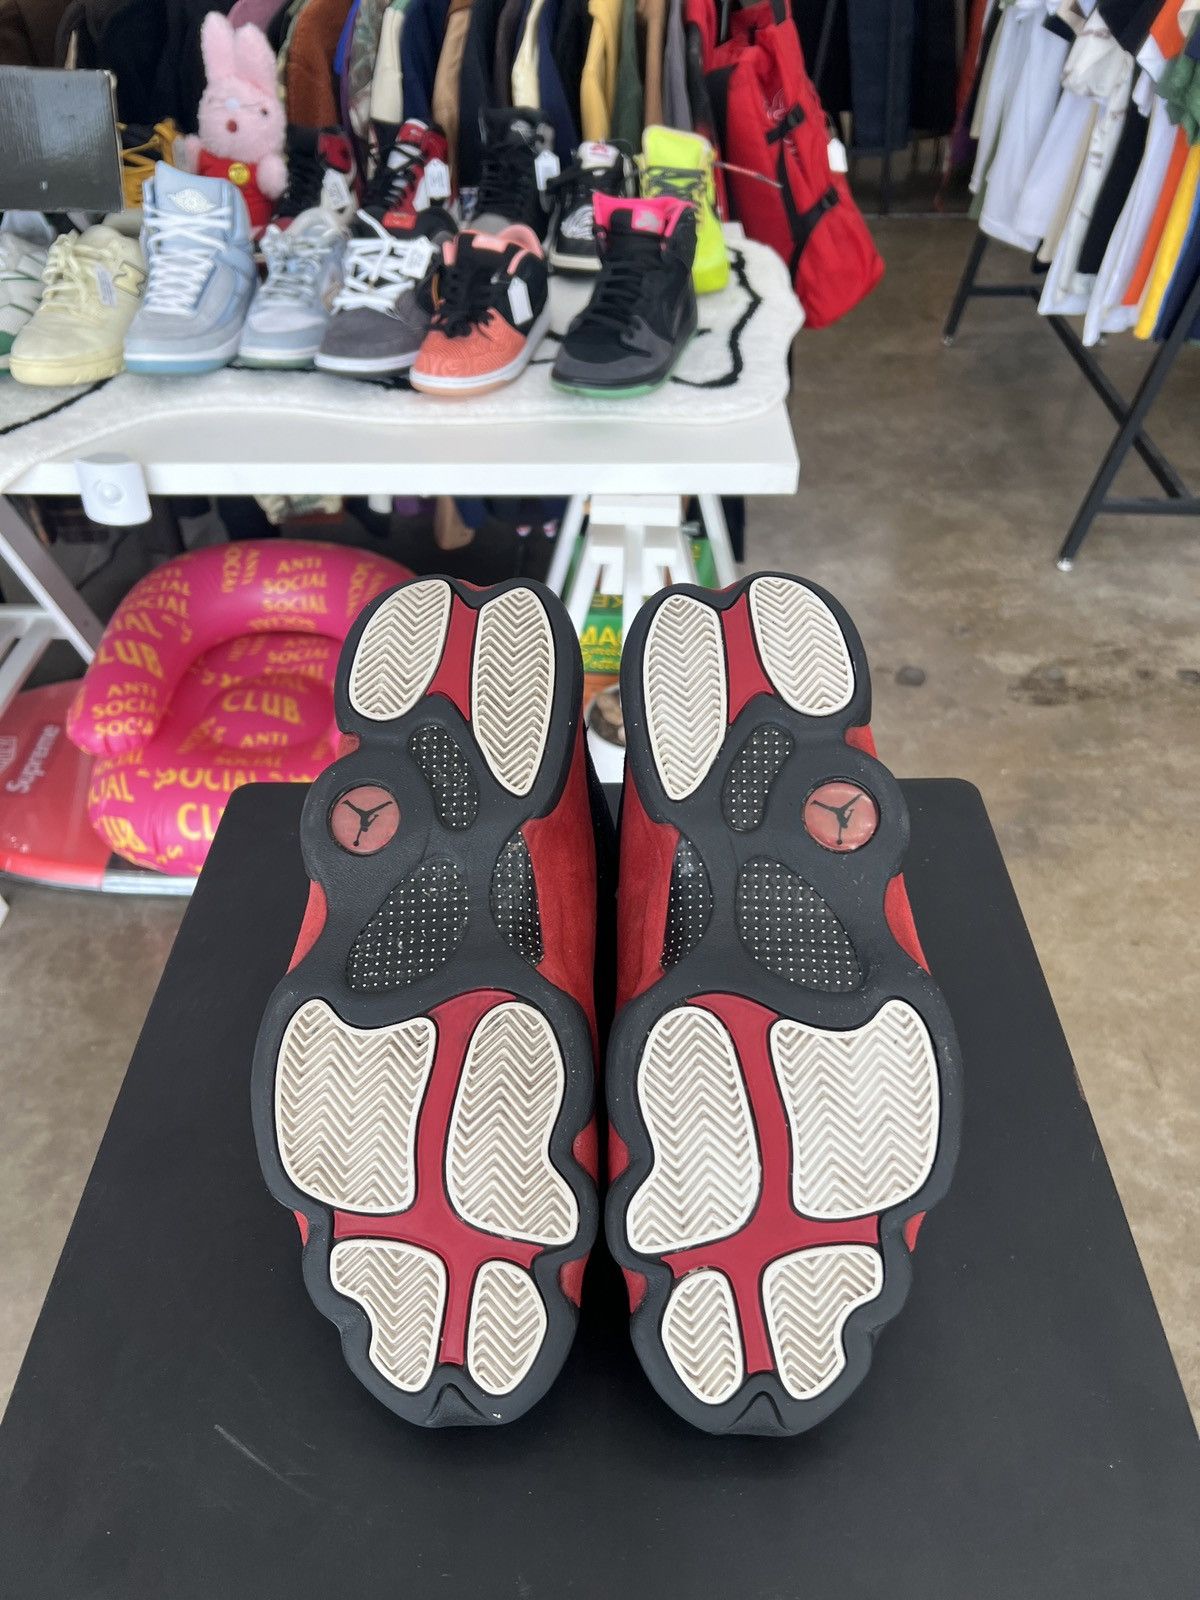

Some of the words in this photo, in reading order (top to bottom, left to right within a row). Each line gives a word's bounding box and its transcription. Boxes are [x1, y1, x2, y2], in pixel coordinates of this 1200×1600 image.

[277, 557, 322, 574] ANTI
[262, 573, 327, 595] SOCIAL
[262, 595, 327, 614] SOCIAL
[580, 624, 622, 647] MA
[98, 639, 164, 679] LUB
[107, 682, 157, 699] ANTI
[221, 691, 302, 726] CLUB
[239, 730, 289, 749] ANTI
[6, 724, 61, 794] Supreme
[176, 802, 226, 842] CL
